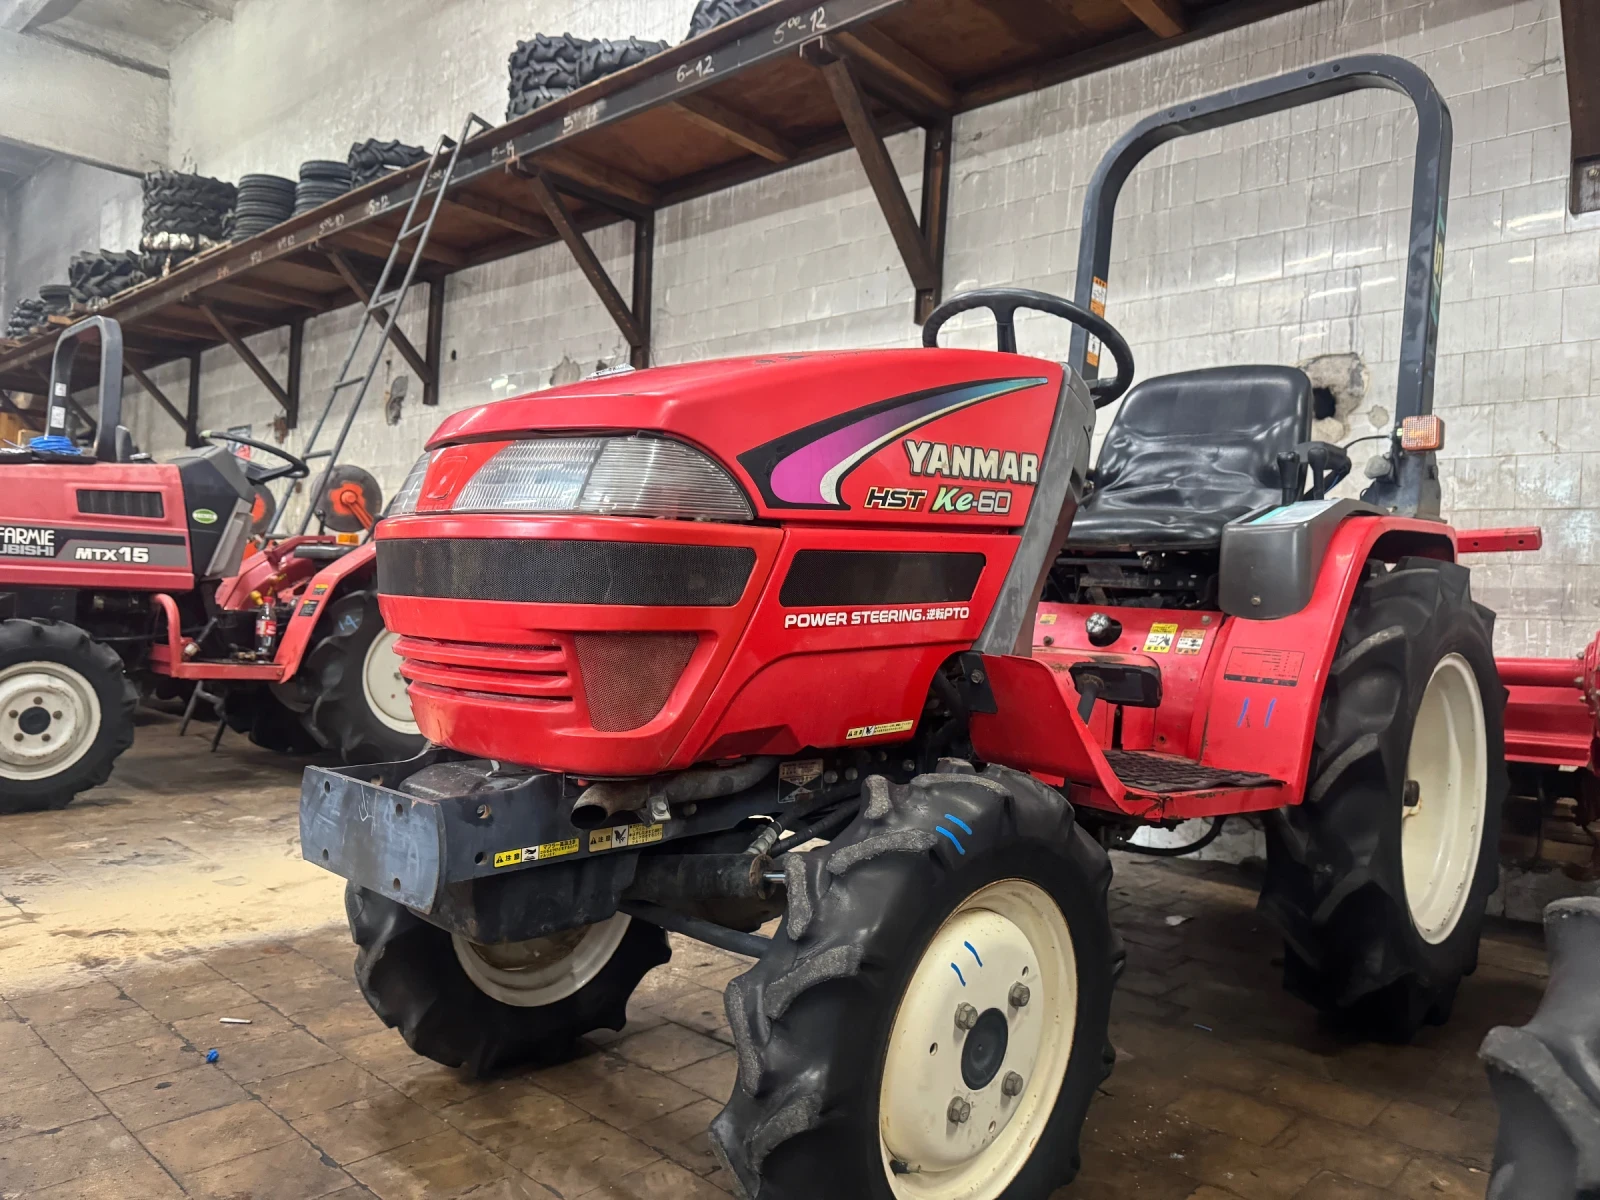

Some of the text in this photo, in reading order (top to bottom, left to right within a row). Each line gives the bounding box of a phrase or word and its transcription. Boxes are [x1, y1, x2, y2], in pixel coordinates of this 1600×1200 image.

[676, 55, 715, 82] 6-12
[905, 439, 1040, 483] YANMAR
[864, 486, 1012, 515] HST Ke-60
[784, 612, 848, 629] POWER
